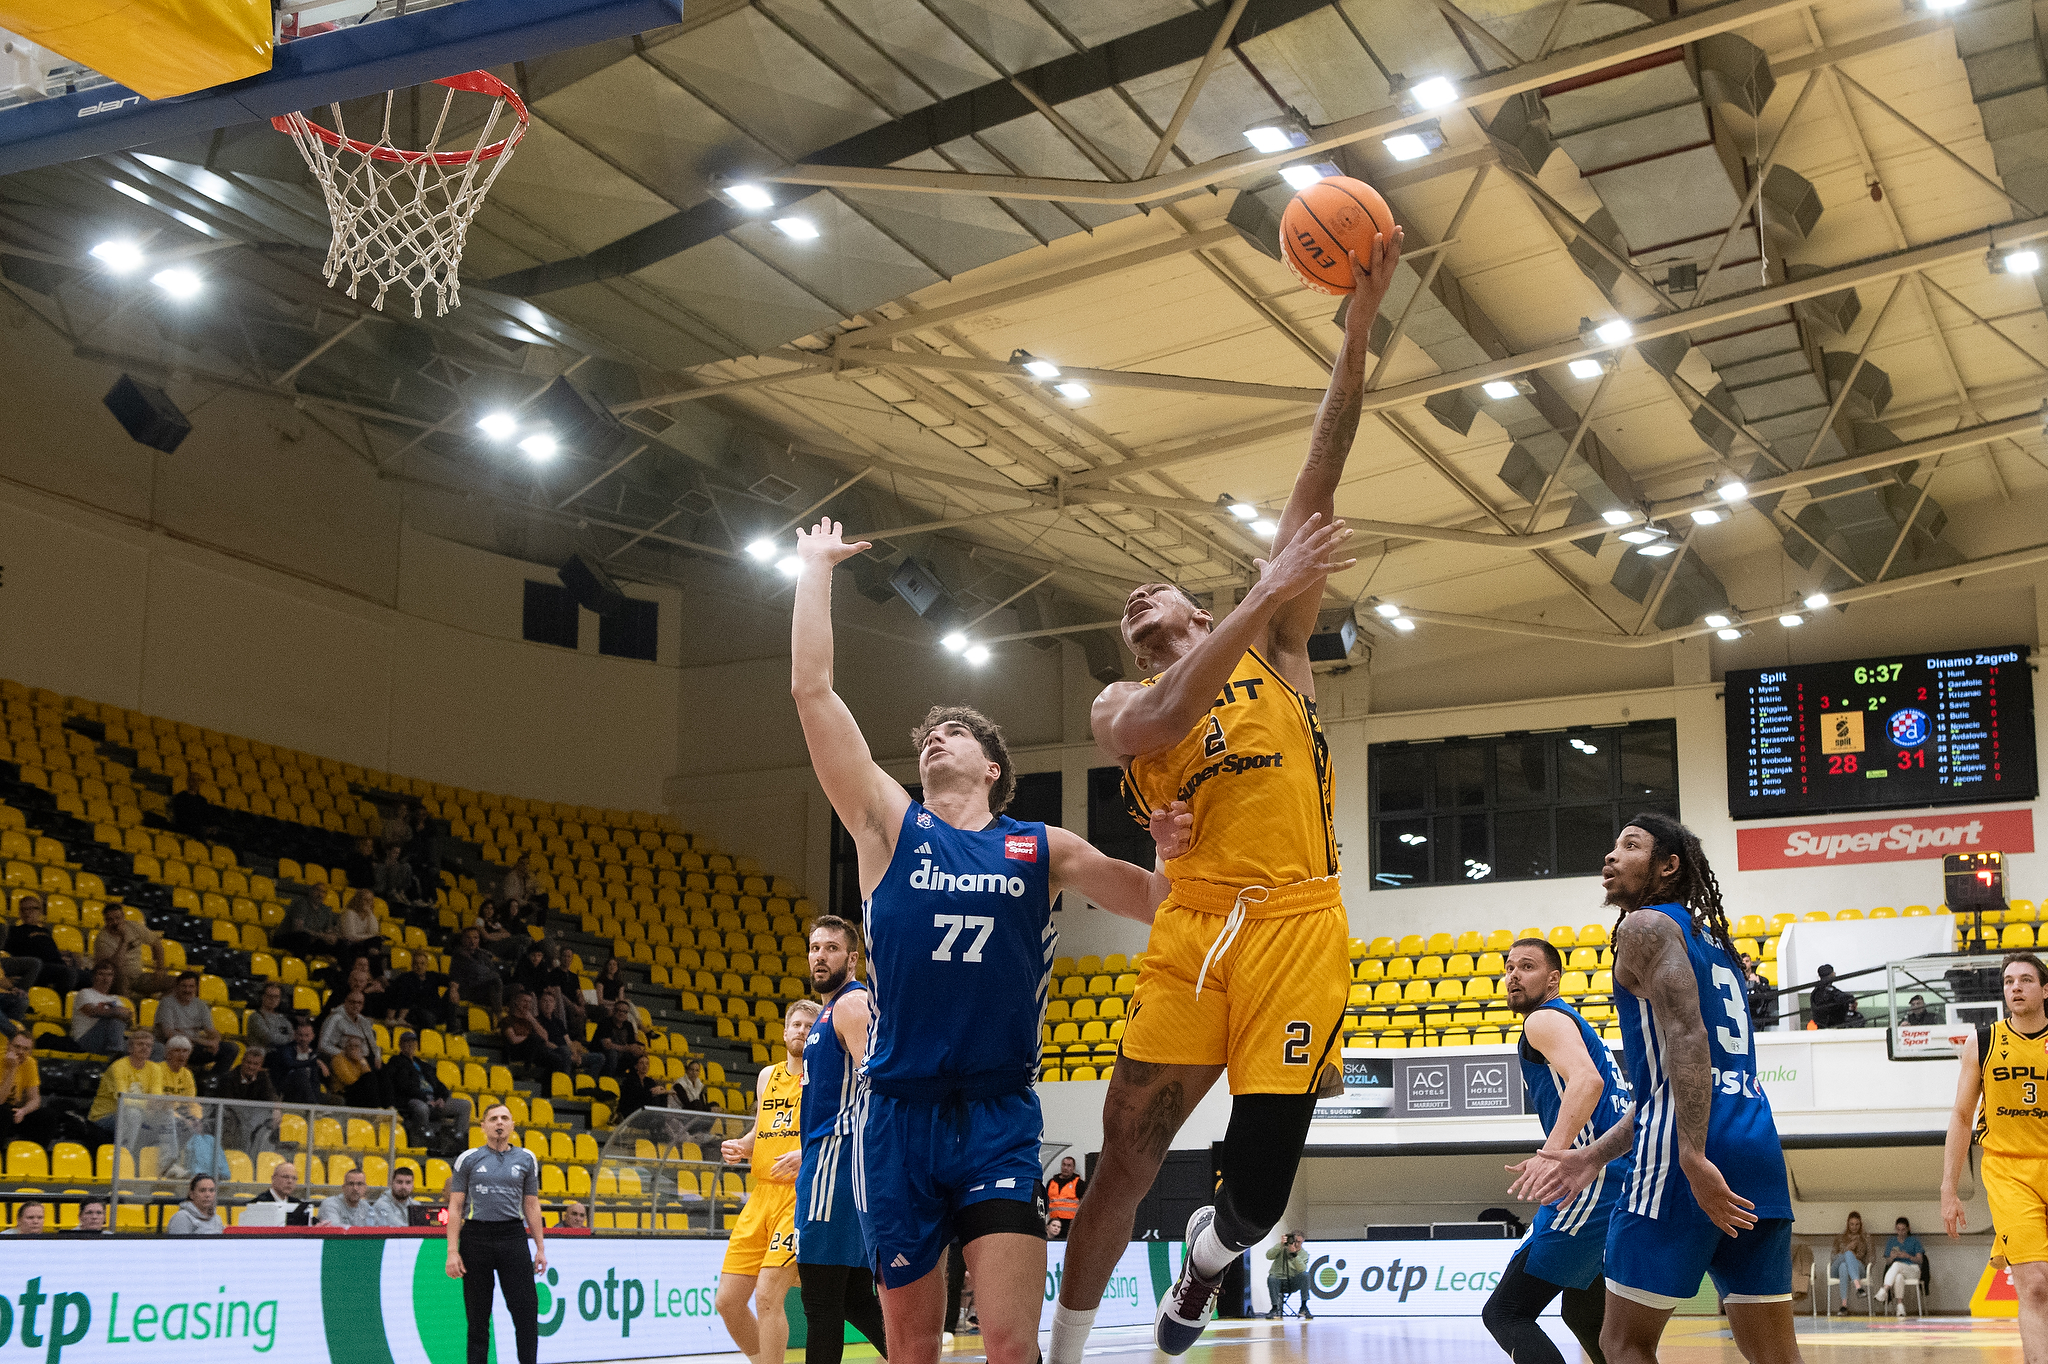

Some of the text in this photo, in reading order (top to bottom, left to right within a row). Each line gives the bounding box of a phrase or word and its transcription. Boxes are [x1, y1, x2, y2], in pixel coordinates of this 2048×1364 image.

[78, 96, 140, 117] elan
[1297, 232, 1337, 269] EVO
[1927, 652, 2018, 669] Dinamo Zagreb
[1760, 672, 1787, 685] Split
[1854, 663, 1903, 685] 6:37
[1947, 670, 1965, 678] Hunt
[1758, 686, 1780, 694] Myers
[1917, 687, 1927, 700] 2
[1990, 688, 1996, 696] 0
[1759, 705, 1788, 714] Wiggins
[1820, 696, 1830, 709] 3
[1868, 697, 1878, 711] 2
[1990, 699, 1996, 707] 0
[1991, 709, 1997, 717] 0
[1203, 714, 1228, 759] 2
[1760, 726, 1789, 734] Jordano
[1800, 755, 1806, 763] 0
[1828, 754, 1858, 774] 28
[1898, 749, 1924, 770] 31
[1994, 762, 2000, 770] 0
[1177, 752, 1283, 802] SuperSport
[1940, 776, 1948, 784] 77
[1995, 773, 2001, 781] 0
[1006, 840, 1035, 848] Super
[1784, 820, 1983, 858] SuperSport
[1009, 846, 1034, 855] Sport
[910, 859, 1025, 898] dinamo
[932, 914, 995, 962] 77
[1711, 962, 1748, 1054] 3
[1902, 1030, 1930, 1038] Super
[1903, 1038, 1929, 1046] Sport
[1283, 1020, 1312, 1066] 2
[1413, 1072, 1444, 1088] AC
[1471, 1069, 1502, 1086] AC
[1757, 1065, 1797, 1082] anka
[2022, 1082, 2037, 1105] 3
[772, 1109, 793, 1130] 24
[770, 1232, 795, 1252] 24
[1045, 1262, 1062, 1301] ot
[1361, 1258, 1500, 1302] otp Leas
[578, 1267, 718, 1338] otp Leasi
[107, 1285, 278, 1352] Leasing
